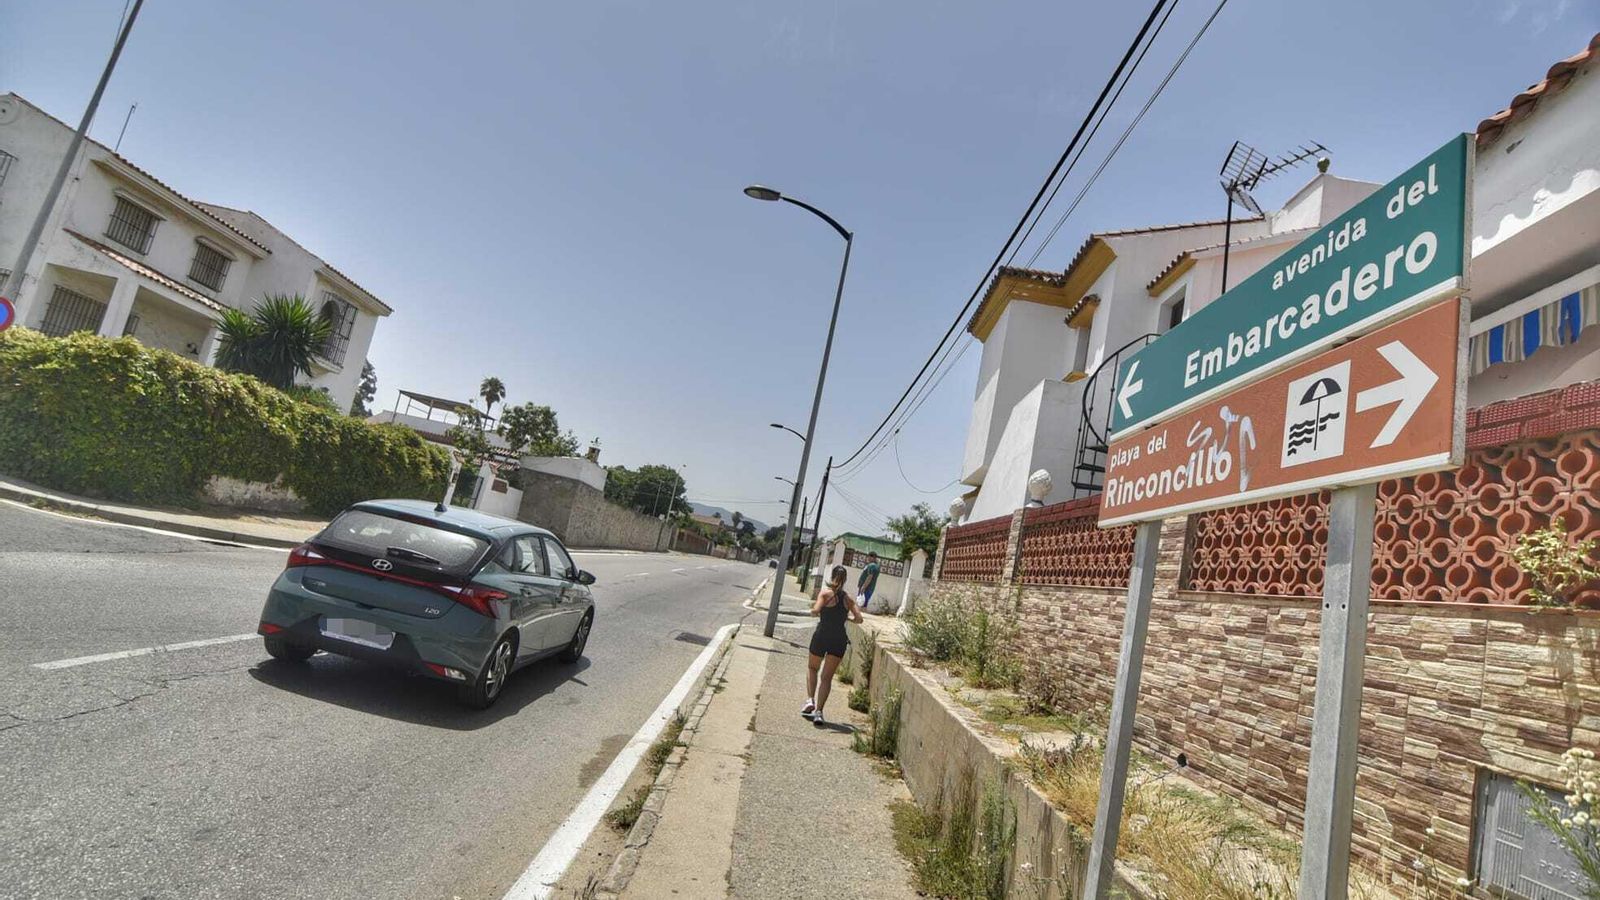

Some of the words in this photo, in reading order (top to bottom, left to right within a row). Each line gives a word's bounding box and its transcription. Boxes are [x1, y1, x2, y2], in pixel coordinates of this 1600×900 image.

[1272, 217, 1367, 290] avenida
[1386, 163, 1439, 220] del
[1184, 231, 1438, 388] Embarcadero
[1104, 444, 1232, 509] Rinconcillo
[1109, 445, 1140, 472] playa
[1147, 430, 1167, 455] del
